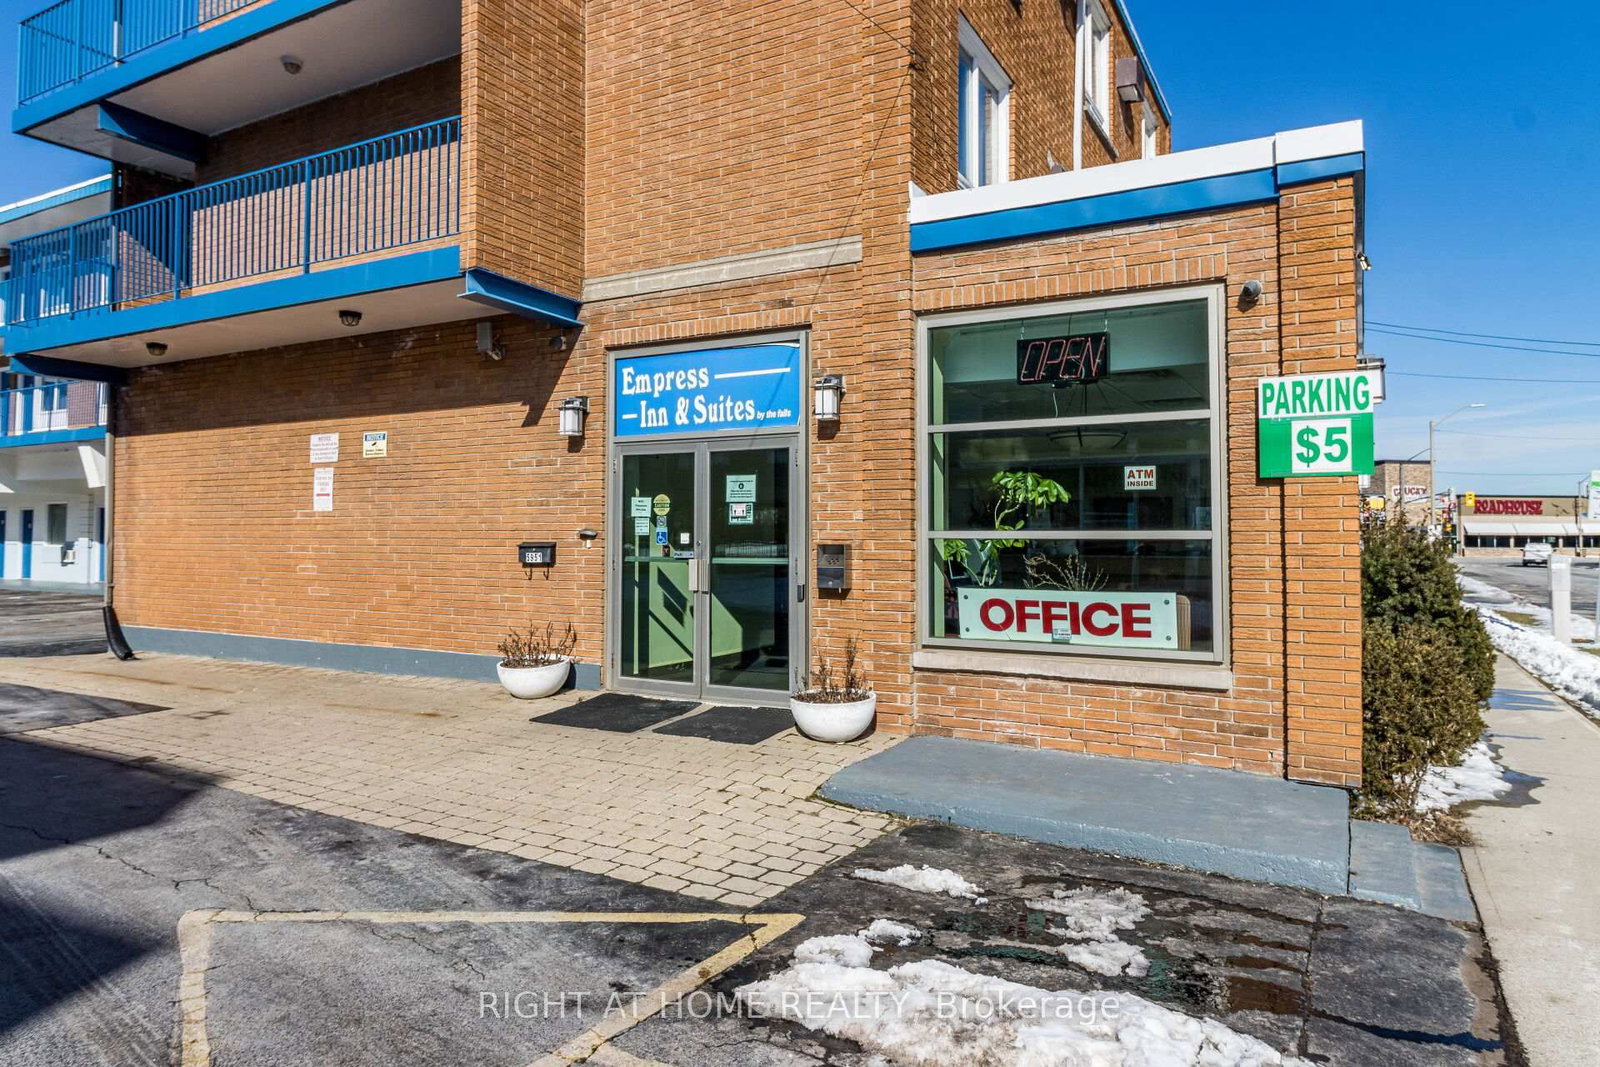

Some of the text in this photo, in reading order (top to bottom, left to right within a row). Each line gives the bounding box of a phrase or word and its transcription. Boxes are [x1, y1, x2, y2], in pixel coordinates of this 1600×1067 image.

[1020, 336, 1106, 381] OPEN
[621, 366, 710, 398] Empress
[1262, 375, 1370, 416] PARKING
[640, 393, 792, 428] Inn & Suites by the falls
[1296, 425, 1349, 468] $5
[1127, 469, 1154, 479] ATM
[1474, 500, 1543, 515] ROADHOUSE
[980, 598, 1152, 638] OFFICE
